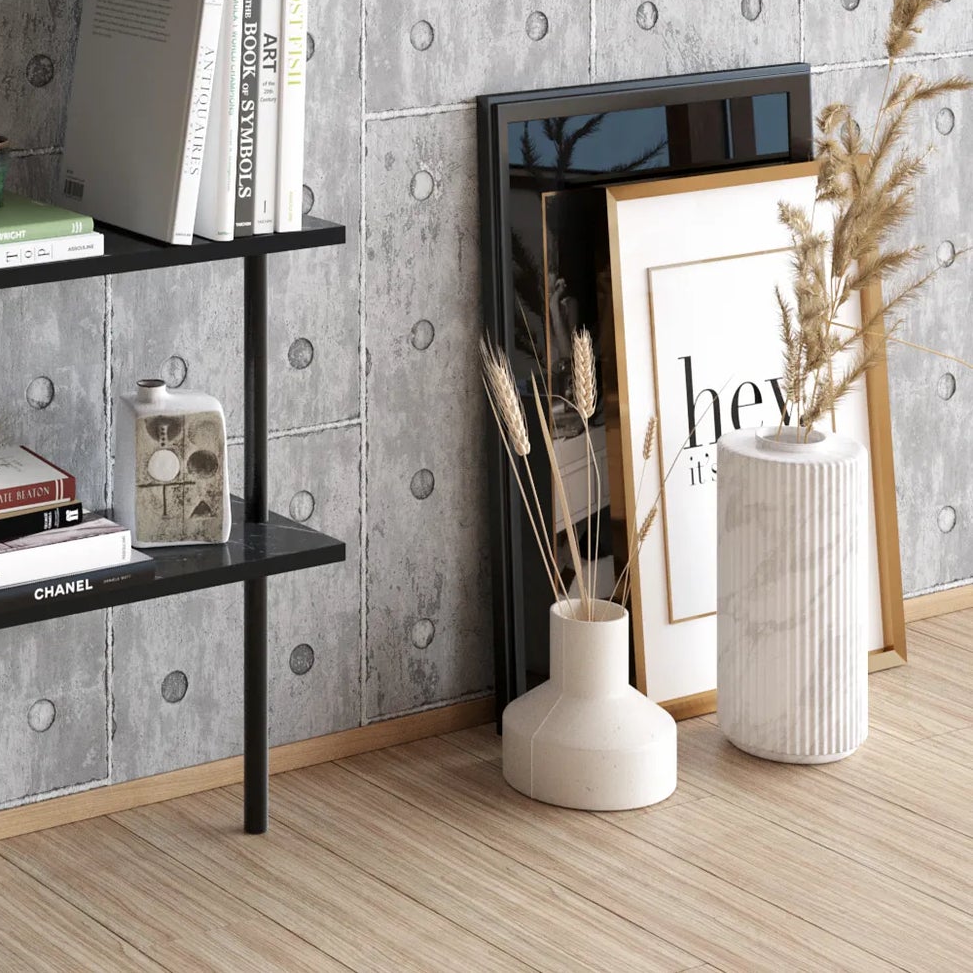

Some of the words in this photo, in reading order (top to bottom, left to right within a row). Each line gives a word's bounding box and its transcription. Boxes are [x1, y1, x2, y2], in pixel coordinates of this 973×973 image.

[242, 21, 258, 79] BOOK
[262, 32, 278, 74] ART
[190, 45, 215, 175] ANTIQUAIRES
[241, 82, 250, 96] OF
[238, 99, 255, 198] SYMBOLS
[16, 486, 51, 501] BEATON
[34, 578, 93, 600] CHANEL
